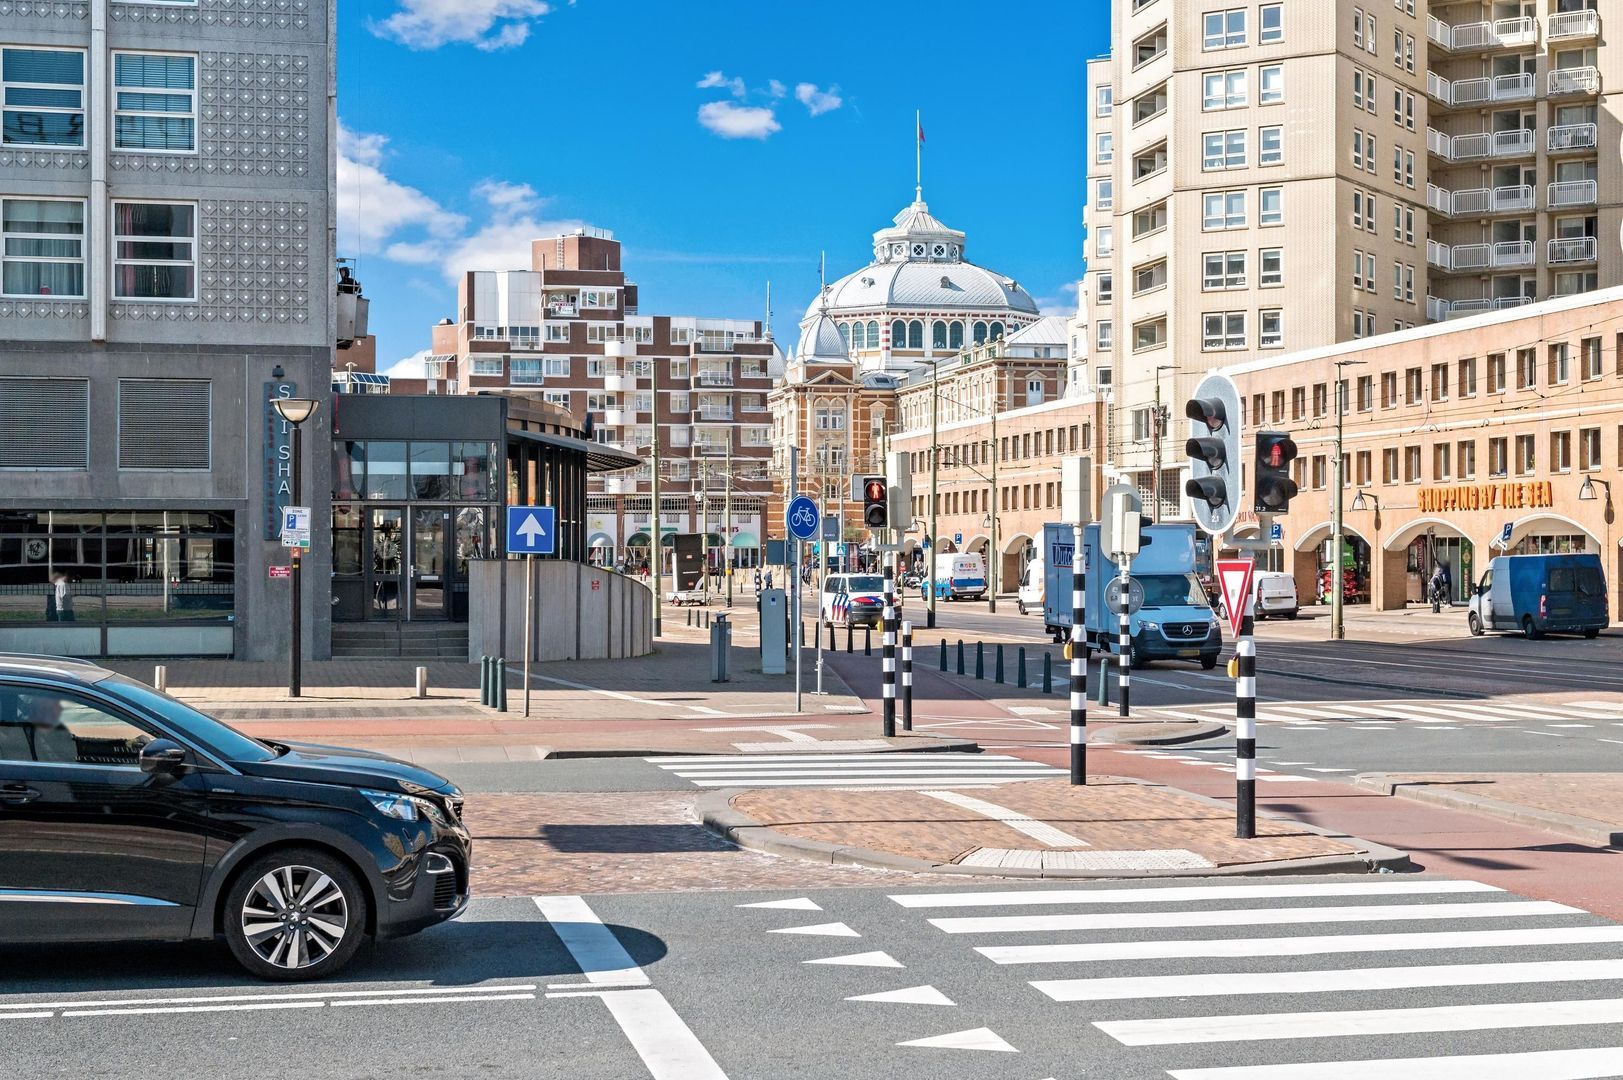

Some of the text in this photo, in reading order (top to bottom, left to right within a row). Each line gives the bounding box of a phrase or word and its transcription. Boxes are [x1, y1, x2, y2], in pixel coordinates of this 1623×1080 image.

[278, 384, 291, 434] SI
[1418, 480, 1553, 512] SHOPPING BY THE SEA
[1273, 525, 1279, 533] P
[1505, 524, 1512, 535] P
